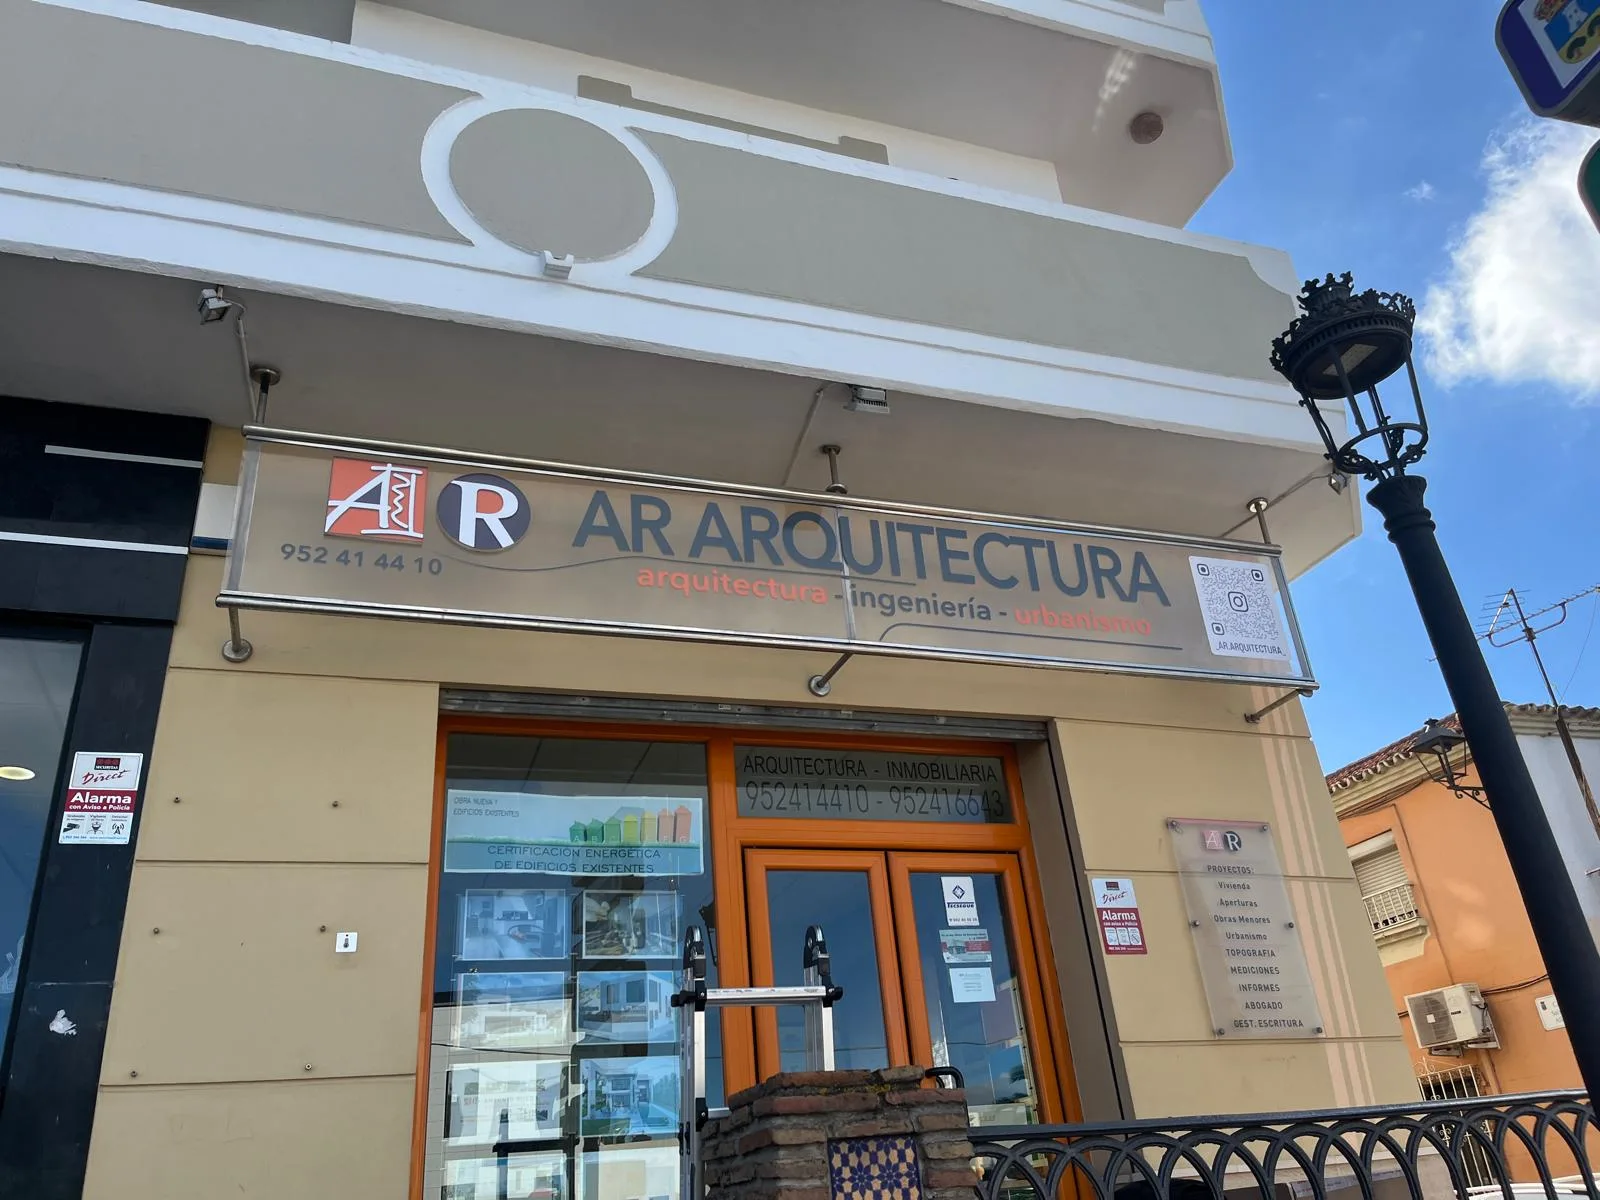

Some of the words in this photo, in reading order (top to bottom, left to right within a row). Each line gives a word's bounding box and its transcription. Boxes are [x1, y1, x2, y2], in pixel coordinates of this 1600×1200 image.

[572, 490, 675, 556] AR
[688, 502, 1172, 608] ARQUITECTURA
[280, 543, 328, 564] 952
[335, 550, 364, 567] 41
[374, 553, 405, 573] 44
[414, 557, 443, 576] 10
[636, 566, 829, 605] arquitectura
[850, 583, 992, 621] ingeniería
[1013, 603, 1152, 638] urbanismo
[744, 755, 868, 778] ARQUITECTURA
[886, 760, 998, 783] INMOBILIARIA
[82, 769, 130, 785] Direct
[71, 792, 132, 804] Alarma
[746, 781, 869, 813] 952414410
[889, 785, 1004, 817] 952416643
[494, 860, 511, 870] DE
[516, 860, 577, 873] EDIFICIOS
[582, 863, 654, 874] EXISTENTES
[1207, 865, 1254, 875] PROYECTOS:
[1218, 881, 1250, 890] Vivienda
[1219, 899, 1258, 908] Aperturas
[1102, 909, 1137, 921] Alarma
[1213, 914, 1237, 923] Obras
[1238, 915, 1271, 924] Menores
[1225, 932, 1267, 940] Urbanismo
[1230, 966, 1280, 975] MEDICIONES
[1238, 983, 1280, 992] INFORMES
[1245, 1001, 1283, 1010] ABOGADO
[1233, 1019, 1257, 1028] GEST.
[1259, 1020, 1304, 1028] ESCRITURA
